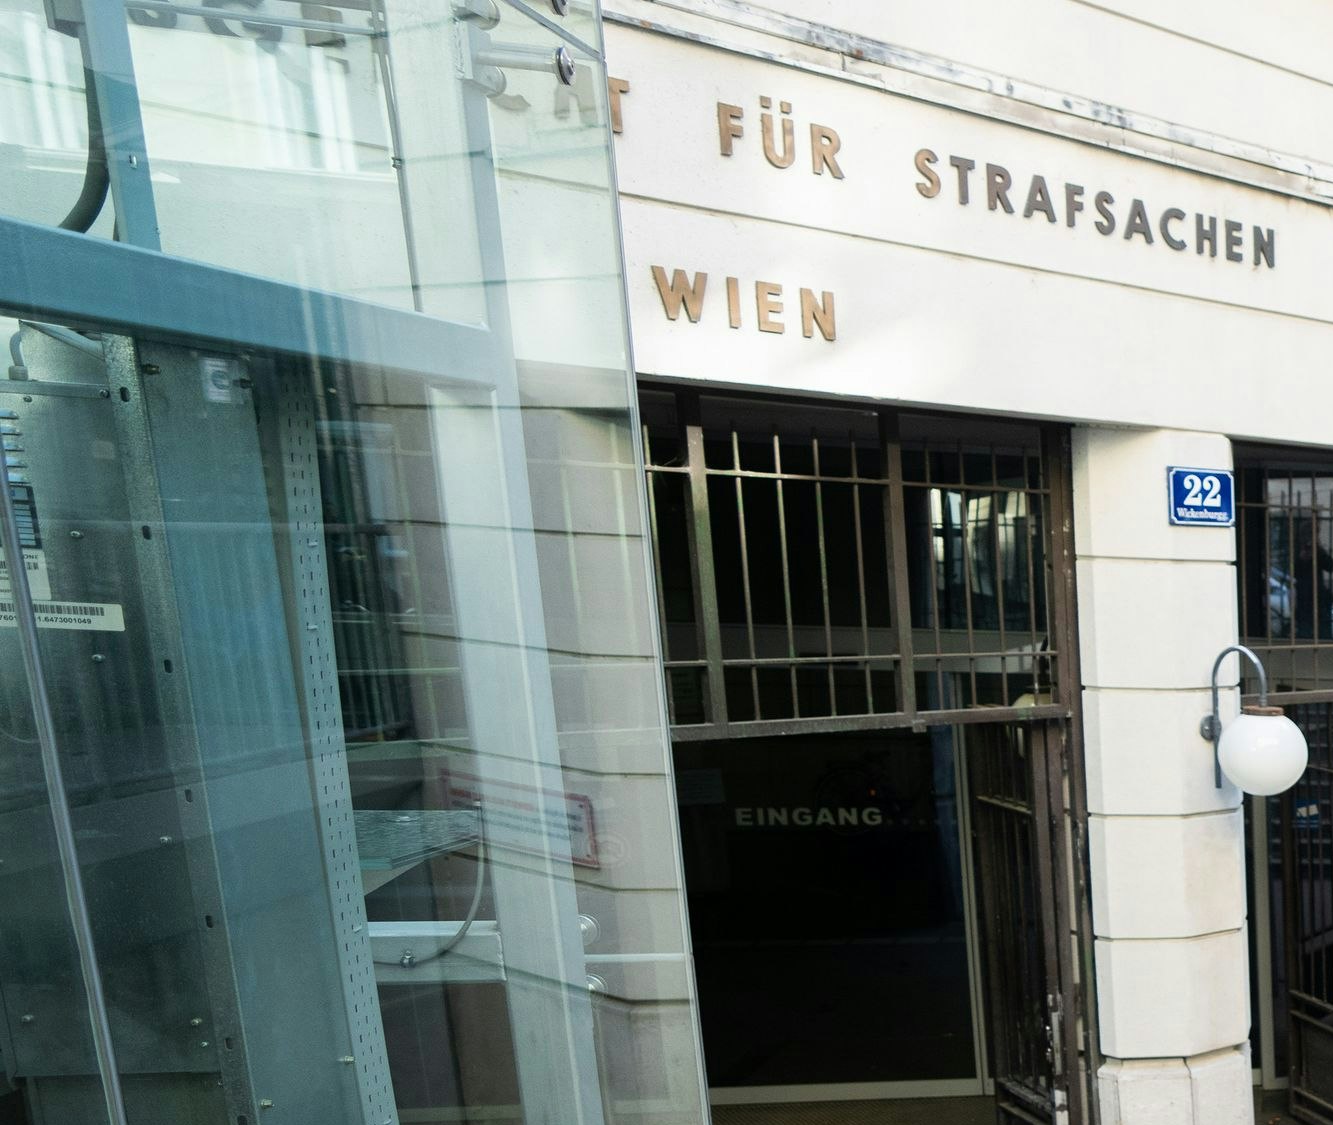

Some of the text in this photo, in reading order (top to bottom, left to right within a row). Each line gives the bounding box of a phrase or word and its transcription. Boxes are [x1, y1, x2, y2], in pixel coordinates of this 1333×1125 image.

[717, 96, 1276, 269] FÜR STRAFSACHEN
[650, 265, 836, 341] WIEN
[1183, 474, 1221, 506] 22
[735, 807, 882, 826] EINGANG
